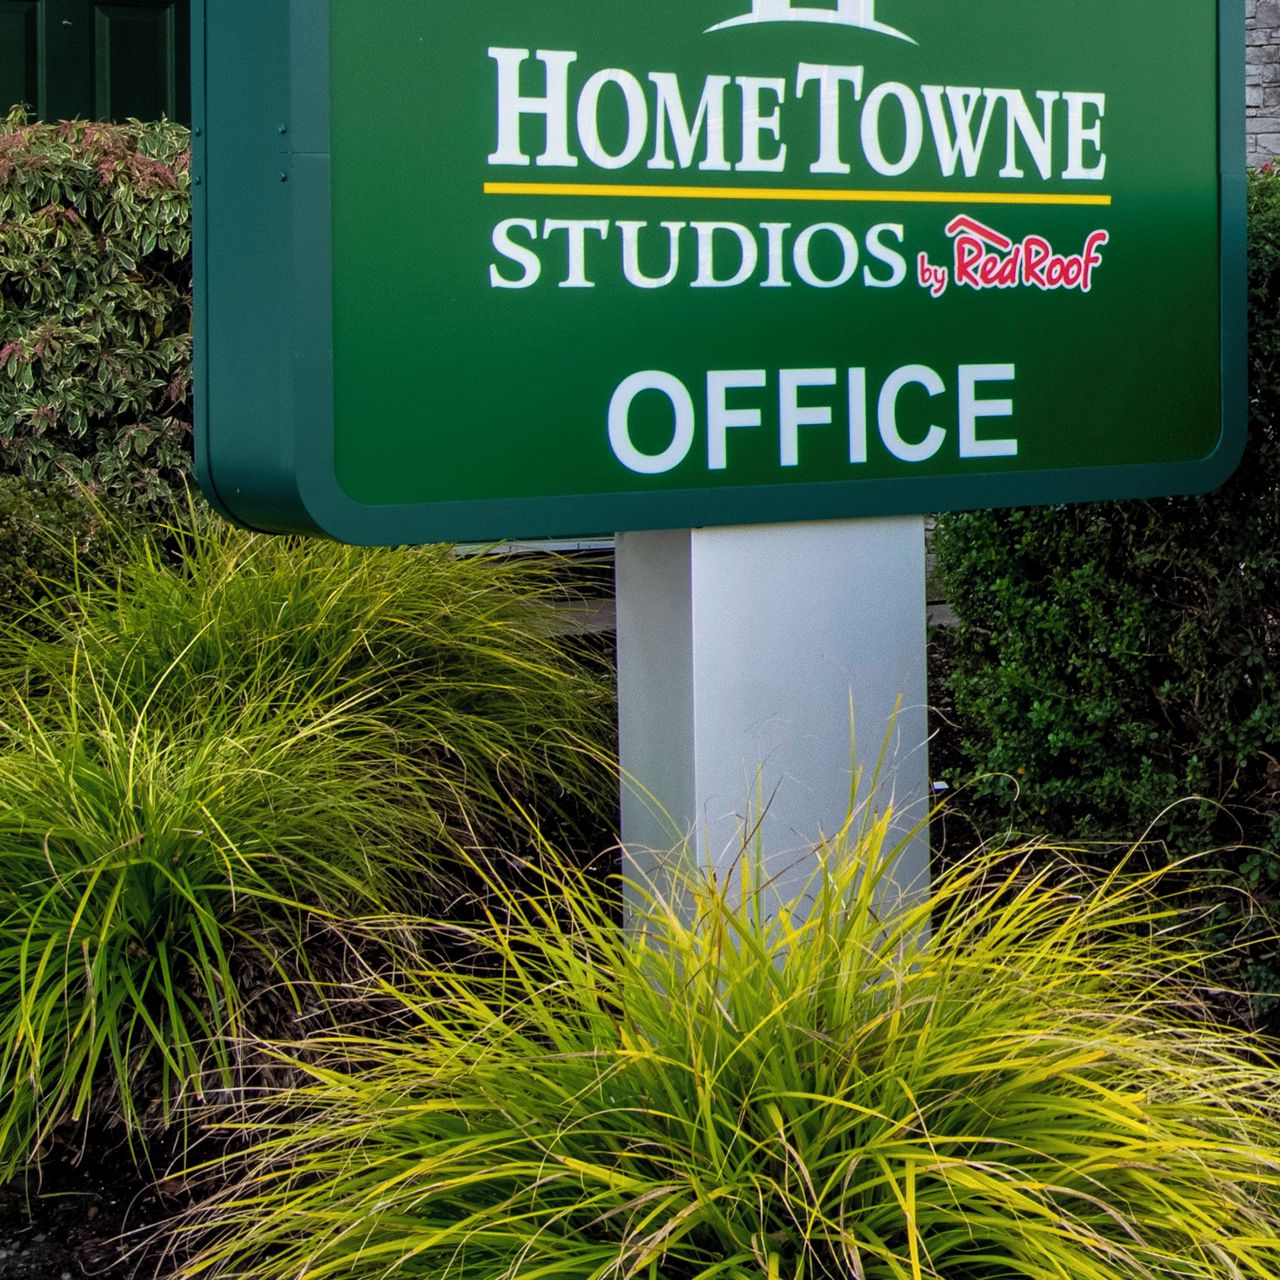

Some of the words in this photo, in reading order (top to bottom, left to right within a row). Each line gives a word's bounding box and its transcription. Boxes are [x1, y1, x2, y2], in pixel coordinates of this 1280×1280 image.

[489, 217, 907, 289] STUDIOS
[917, 251, 949, 298] by
[608, 363, 1018, 473] OFFICE
